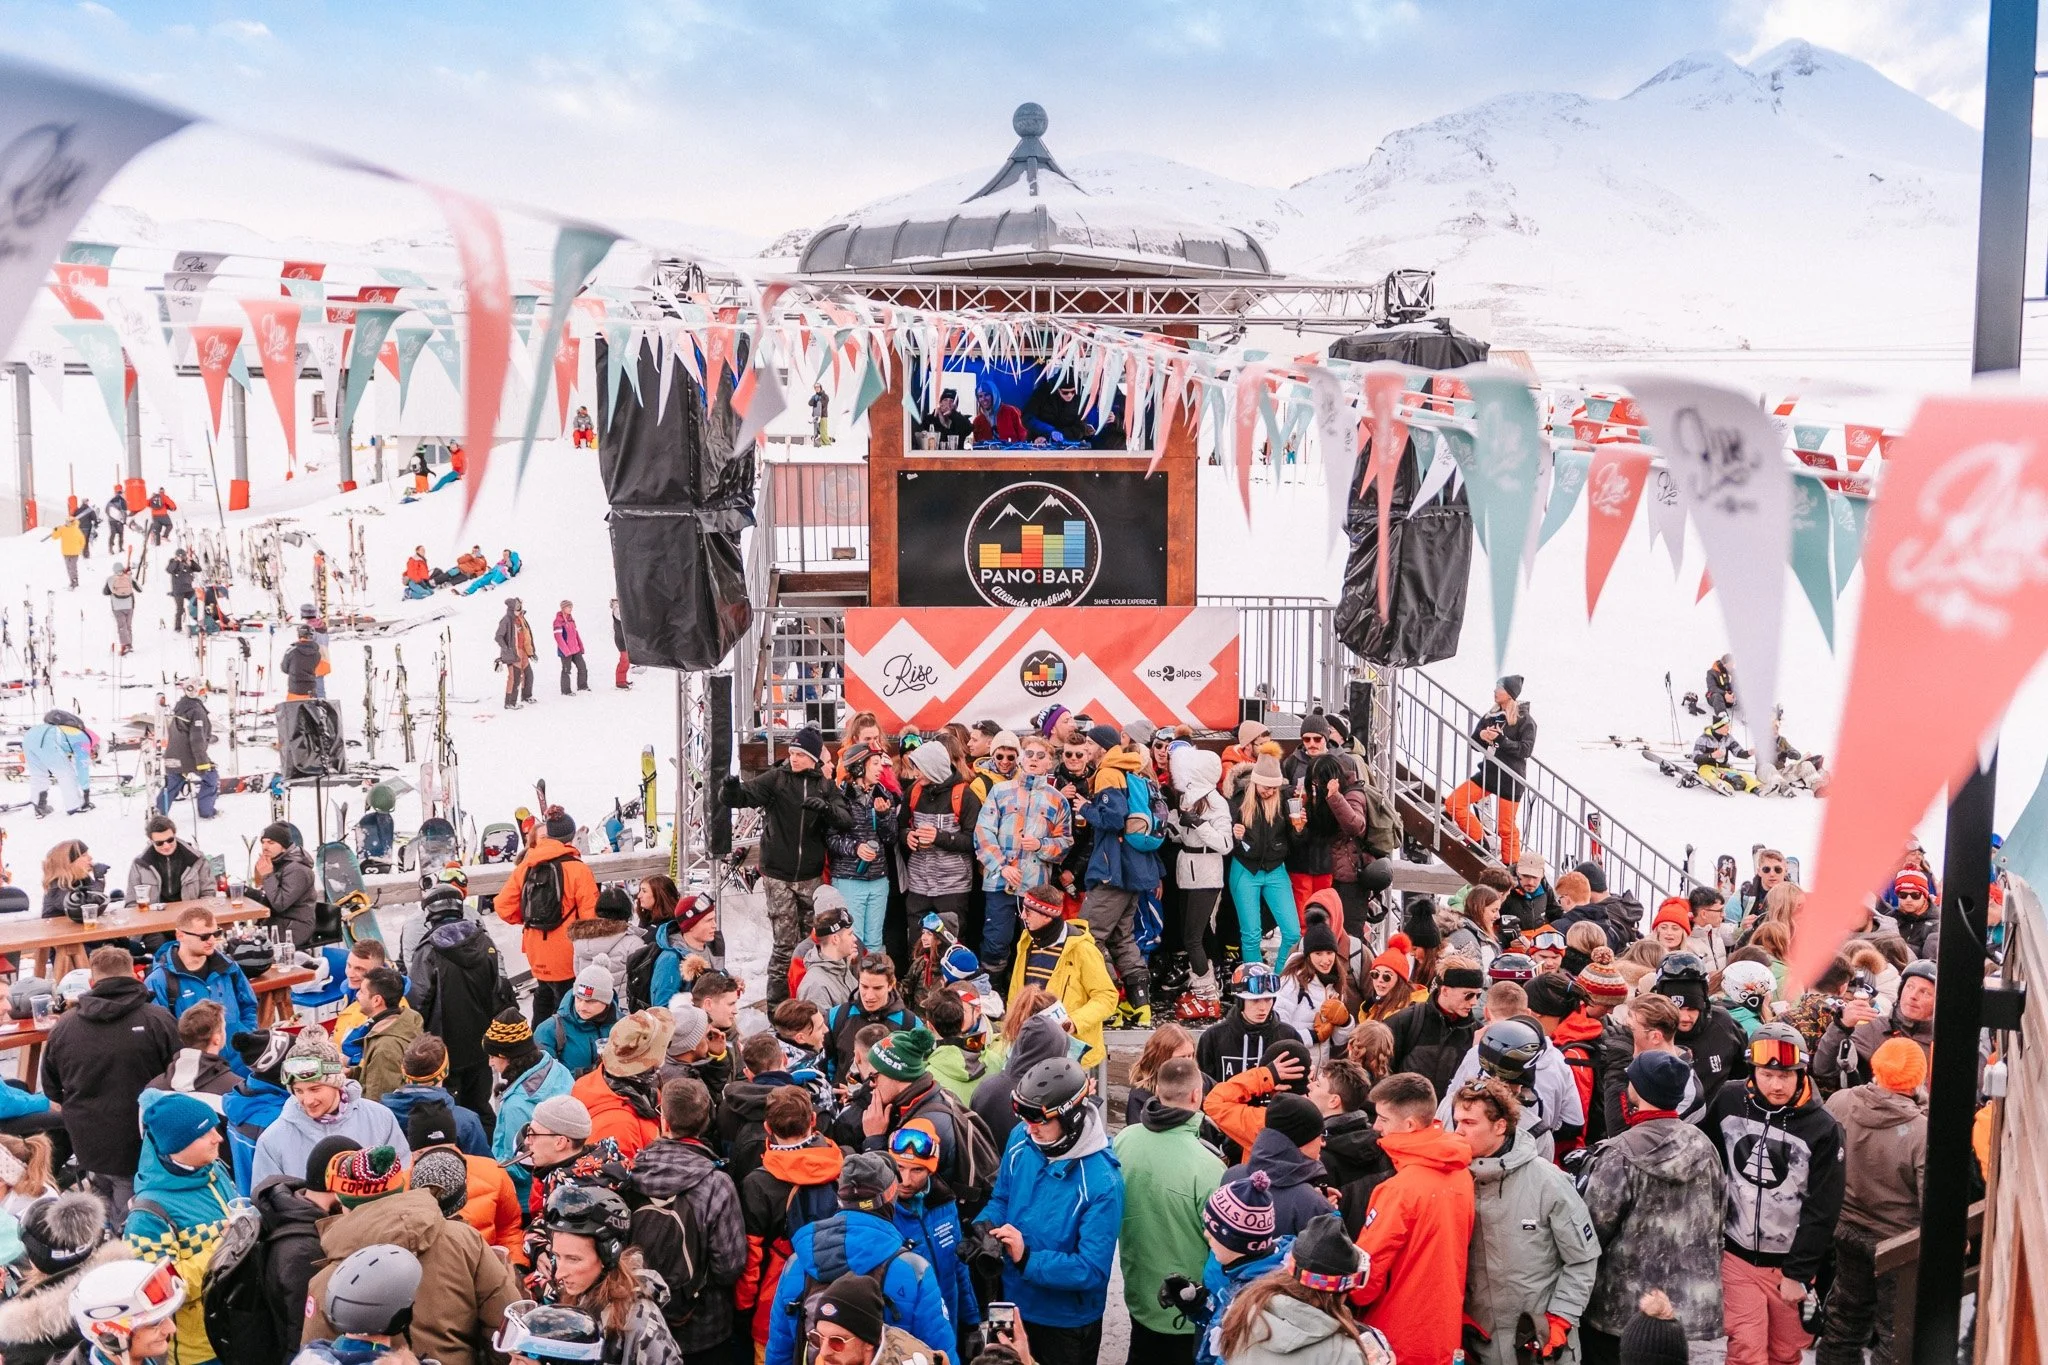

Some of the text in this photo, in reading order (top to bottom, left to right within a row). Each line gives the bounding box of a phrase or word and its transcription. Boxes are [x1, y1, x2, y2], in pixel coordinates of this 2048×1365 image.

[178, 255, 209, 272] Rise
[980, 568, 1036, 584] PANO
[1043, 568, 1084, 584] BAR
[990, 585, 1072, 608] Altitude Clubbing
[1093, 598, 1158, 606] SHARE YOUR EXPERIENCE
[882, 652, 939, 697] Rise
[1147, 668, 1162, 678] les
[1162, 665, 1175, 682] 2
[1175, 668, 1202, 680] alpes
[340, 1180, 389, 1197] COPOZZ
